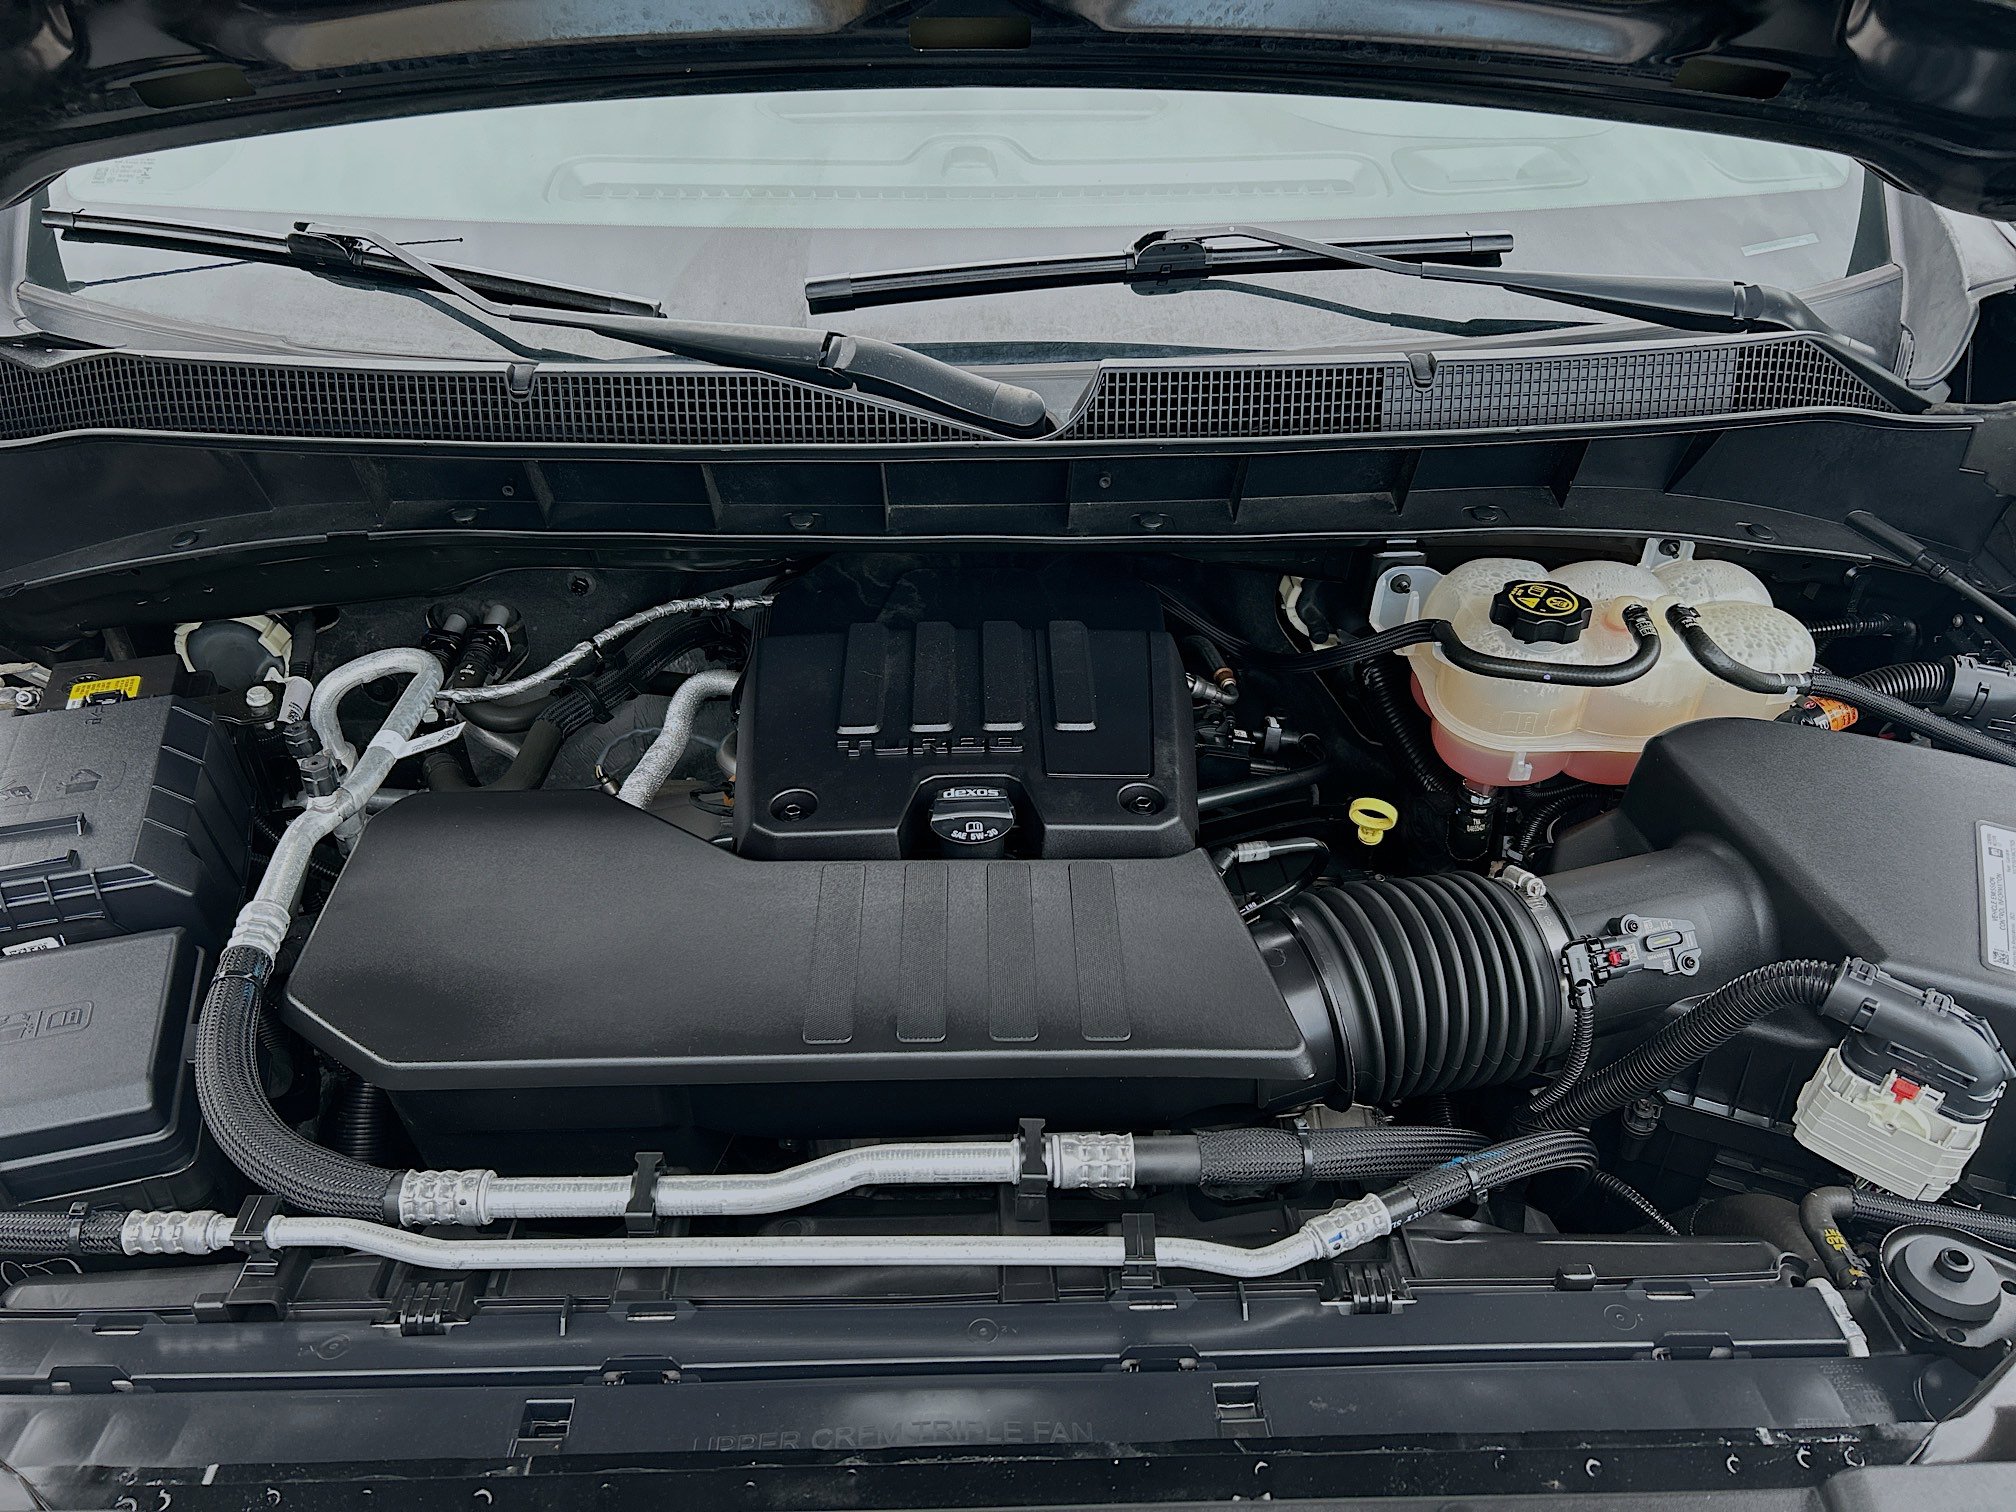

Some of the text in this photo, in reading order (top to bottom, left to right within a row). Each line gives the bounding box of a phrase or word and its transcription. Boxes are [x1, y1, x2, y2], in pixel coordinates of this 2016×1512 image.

[943, 788, 1000, 799] dexos
[951, 828, 999, 840] SAE 5W-30
[693, 1430, 800, 1451] UPPER
[911, 1420, 1024, 1443] TRIPLE
[1034, 1421, 1094, 1444] FAN
